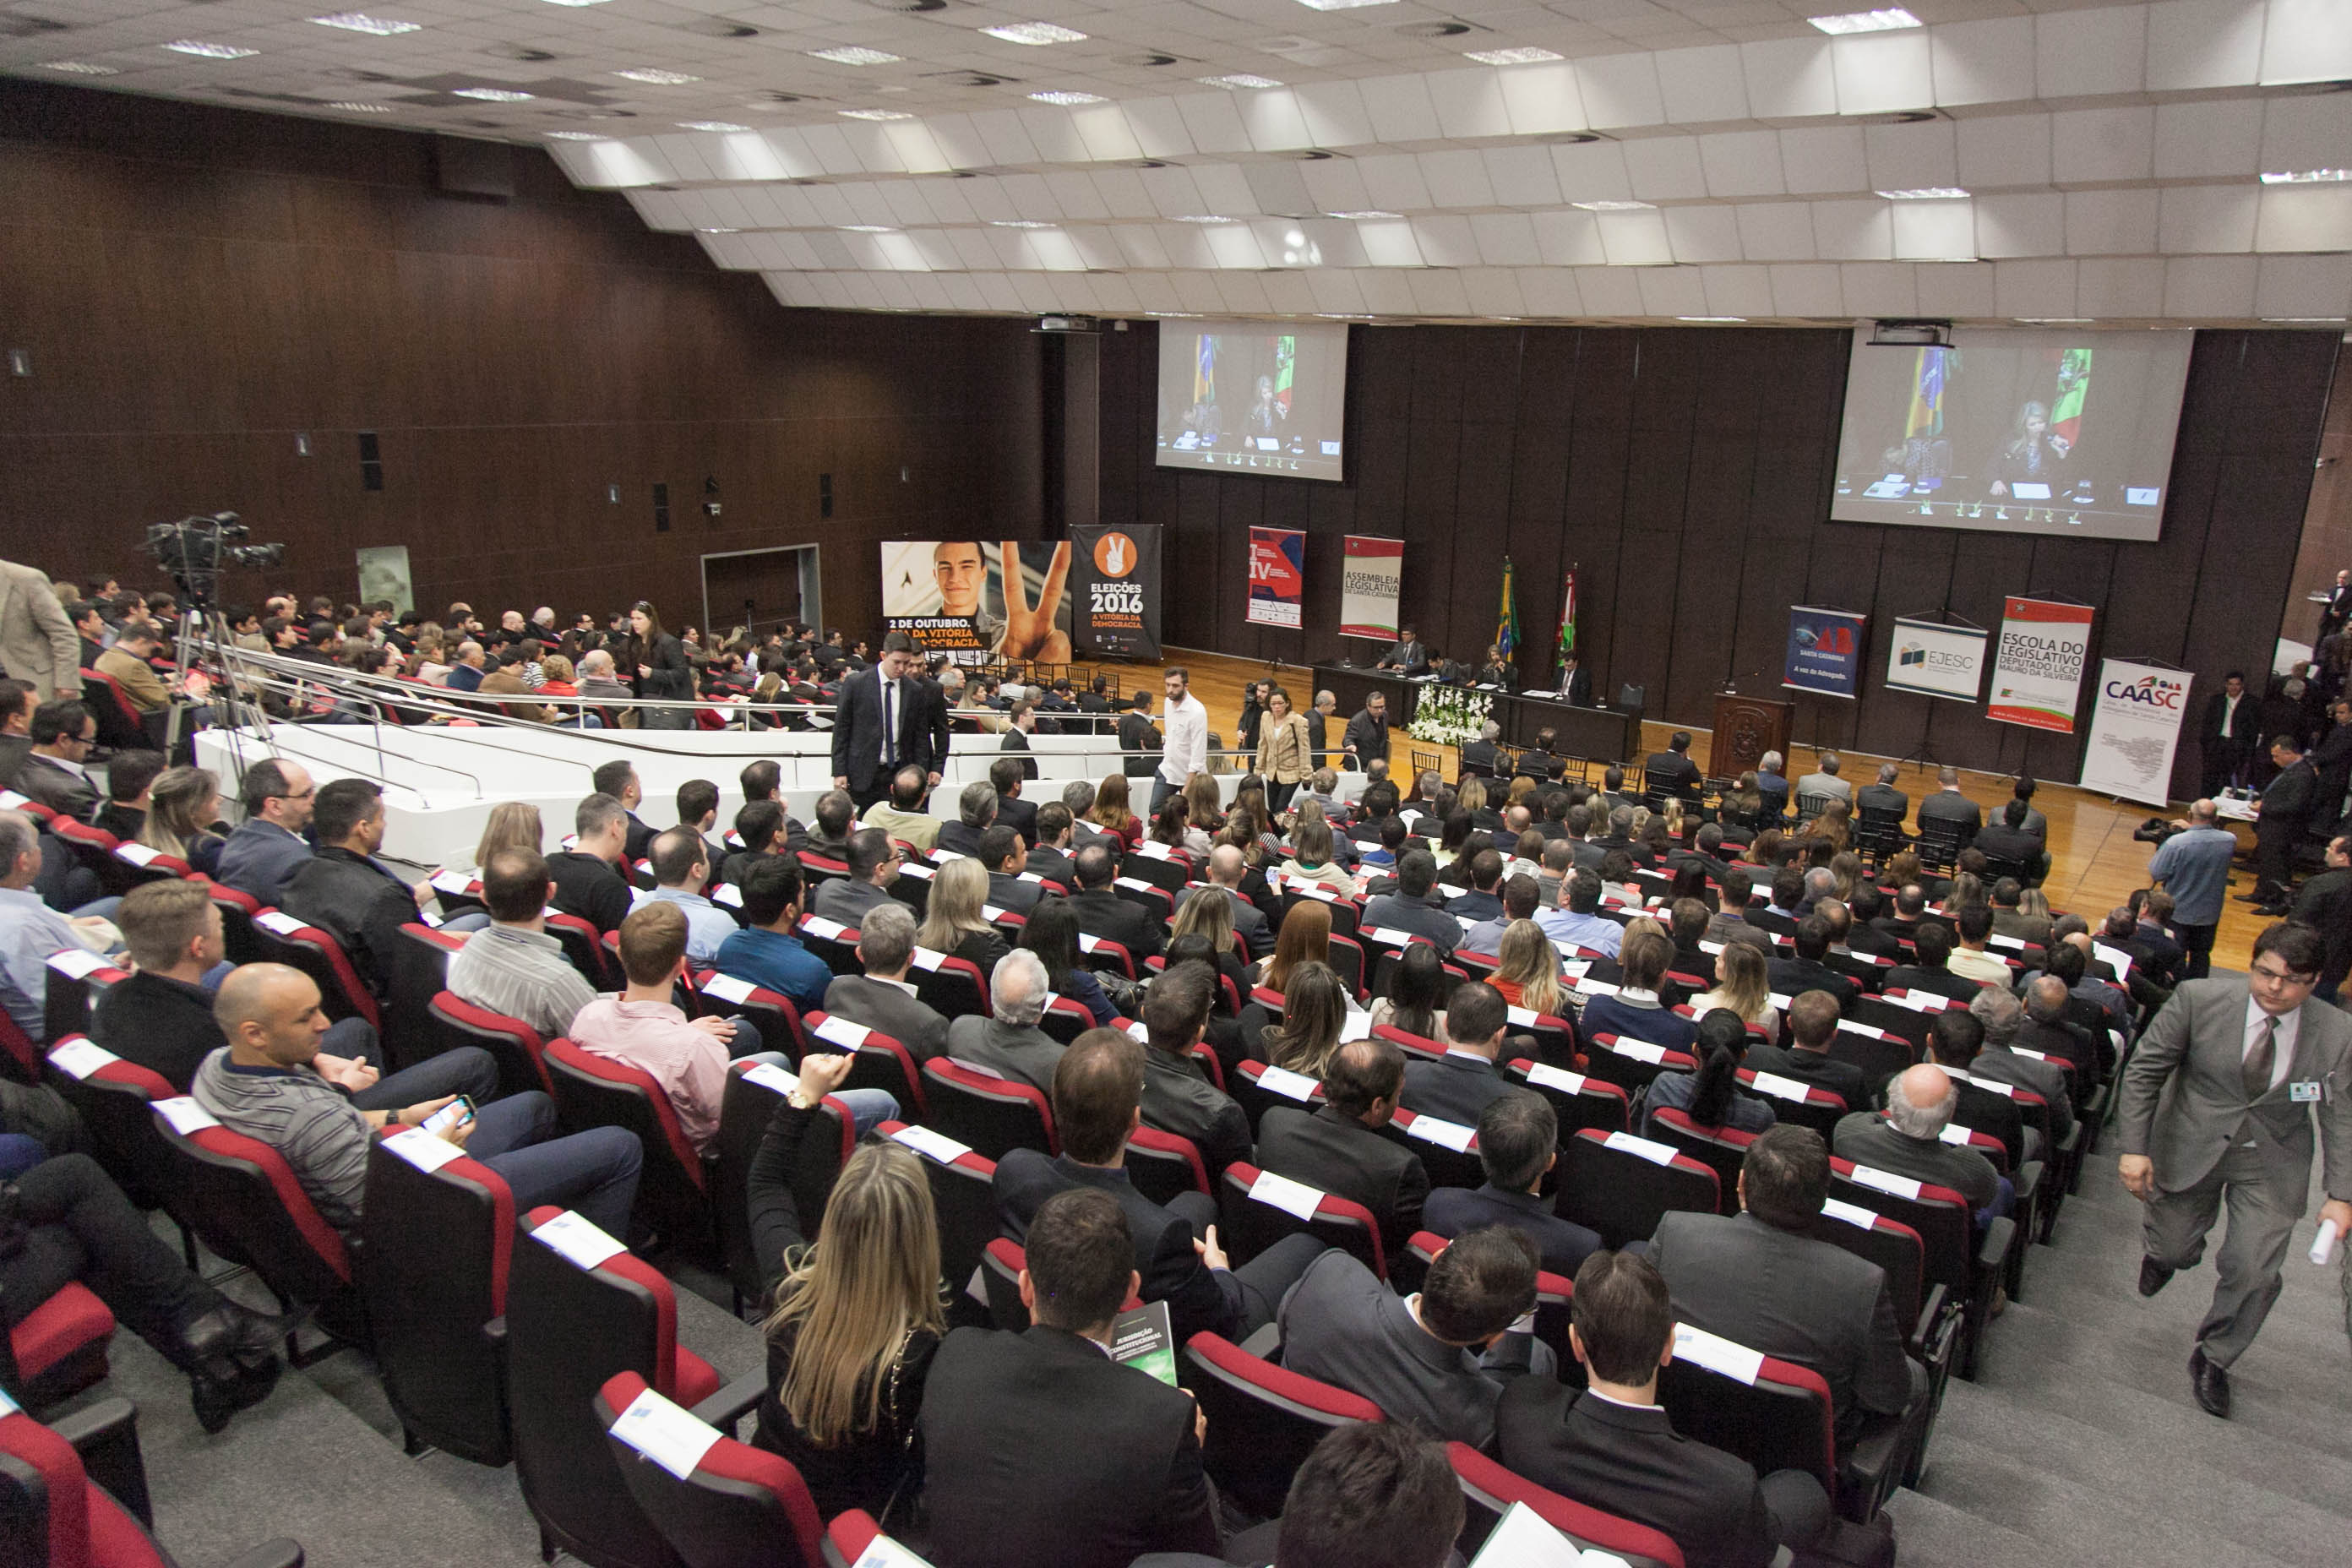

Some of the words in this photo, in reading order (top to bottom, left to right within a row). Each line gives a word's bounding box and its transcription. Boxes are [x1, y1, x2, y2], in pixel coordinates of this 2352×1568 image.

[1250, 561, 1271, 580] IV
[1346, 571, 1399, 585] ASSEMBLEIA
[1091, 581, 1142, 596] ELEIÇÕES
[1345, 580, 1398, 593] LEGISLATIVA
[1091, 593, 1143, 614] 2016
[889, 619, 896, 629] 2
[898, 619, 913, 629] DE
[915, 618, 971, 629] OUTUBRO.
[1092, 621, 1143, 629] DEMOCRACIA.
[912, 629, 927, 638] DA
[929, 628, 973, 638] VITÓRIA
[2002, 632, 2056, 651] ESCOLA
[2061, 641, 2084, 655] DO
[1929, 651, 1974, 669] EJESC
[2001, 645, 2082, 667] LEGISLATIVO
[1998, 663, 2028, 674] MAURO
[2029, 668, 2041, 677] DA
[2043, 671, 2078, 683] SILVEIRA
[1999, 656, 2052, 671] DEPUTADO
[2054, 664, 2080, 676] LÍCIO
[2106, 681, 2180, 710] CAASC
